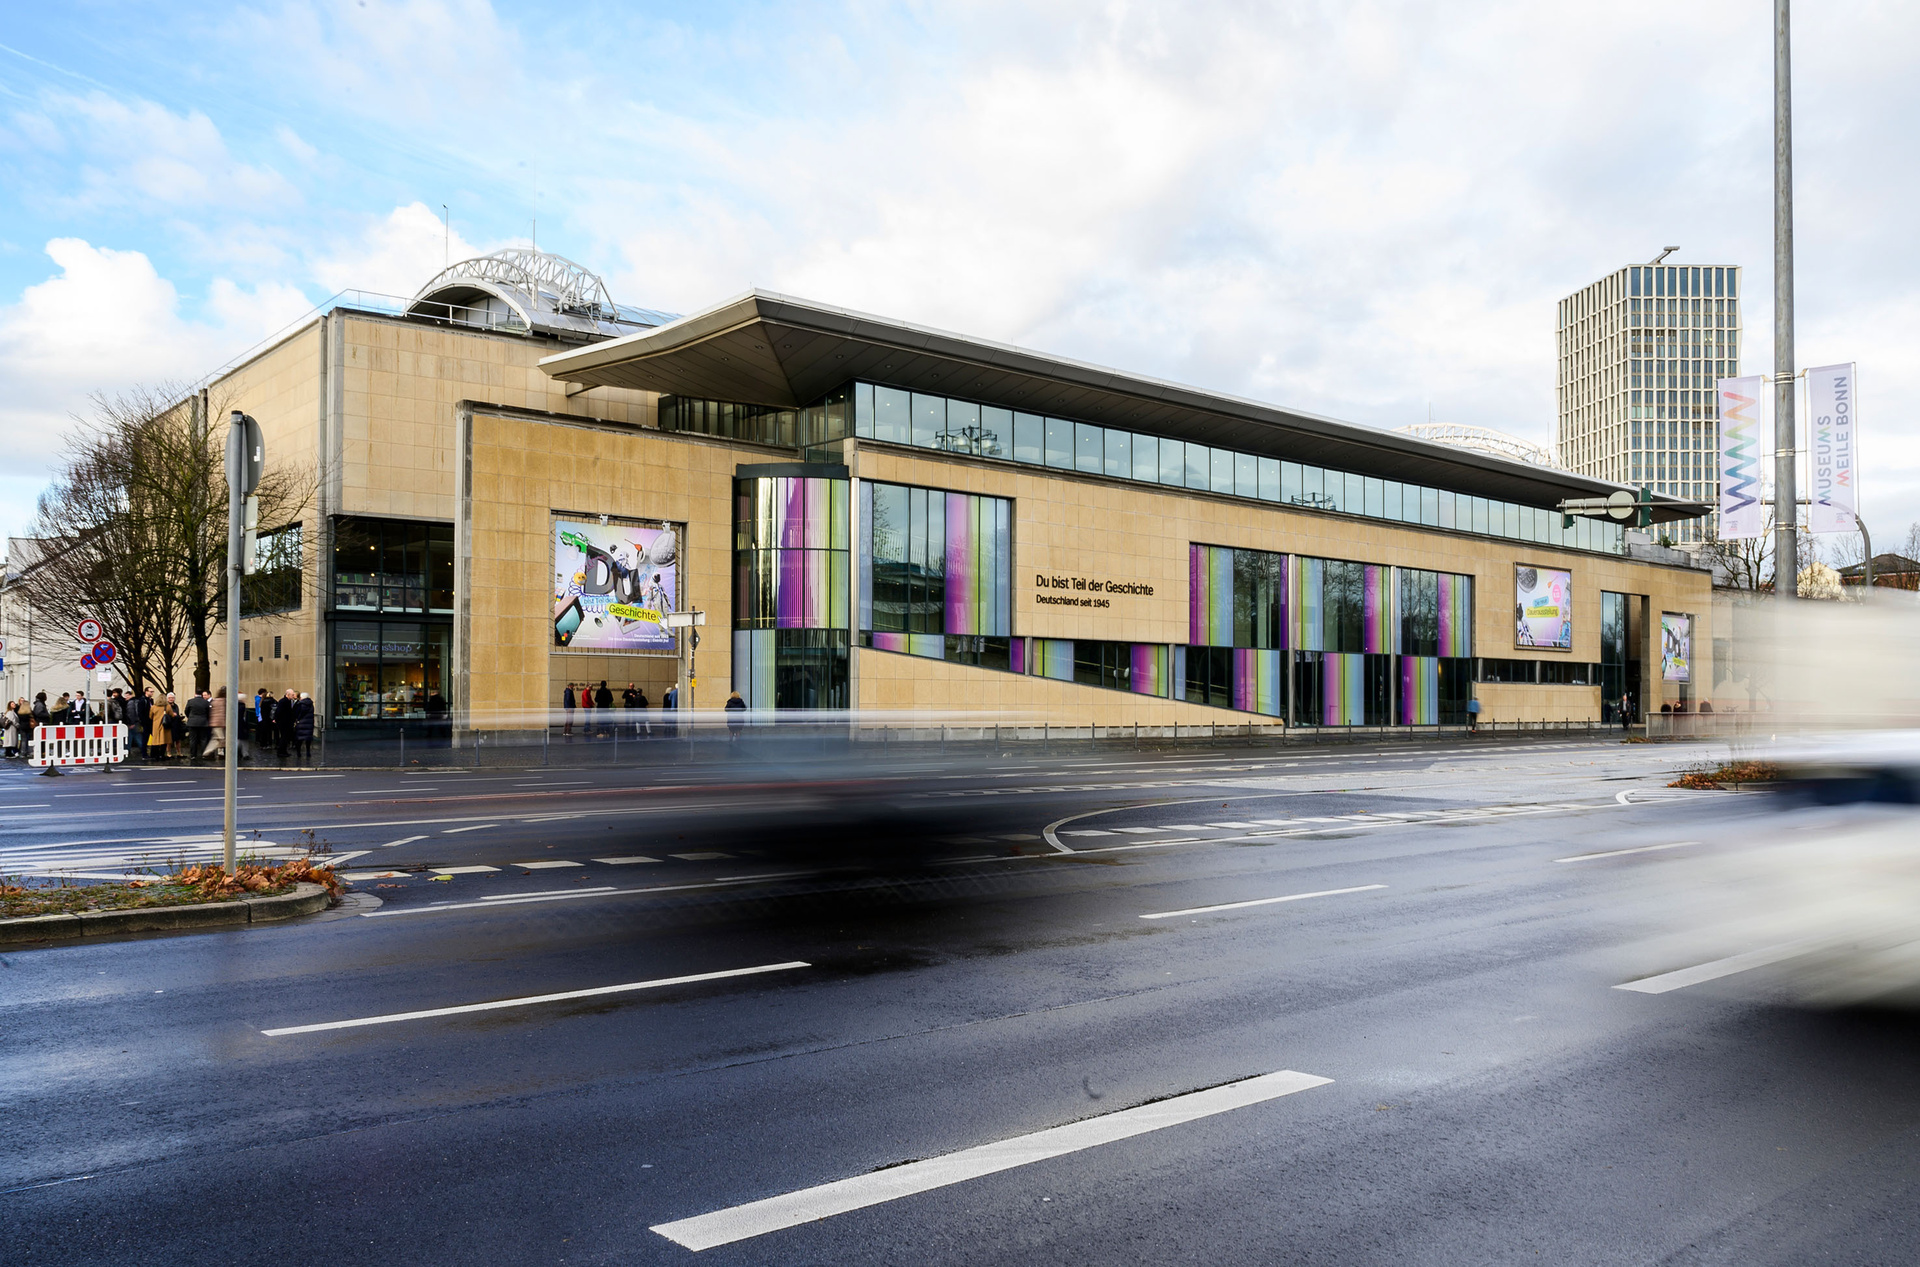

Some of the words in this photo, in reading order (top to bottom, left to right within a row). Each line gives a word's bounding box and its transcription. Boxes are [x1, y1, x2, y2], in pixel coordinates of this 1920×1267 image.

[1834, 376, 1849, 426] BONN
[1817, 415, 1831, 506] MUSEUMS
[1836, 431, 1850, 488] MEILE
[1036, 574, 1049, 587] Du
[1052, 576, 1069, 589] bist
[1071, 577, 1086, 590] Teil
[1088, 579, 1104, 592] der
[1105, 580, 1154, 596] Geschichte
[1036, 594, 1079, 606] Deutschland
[1080, 597, 1092, 607] seit
[1093, 599, 1110, 608] 1945
[609, 604, 657, 621] Geschichte
